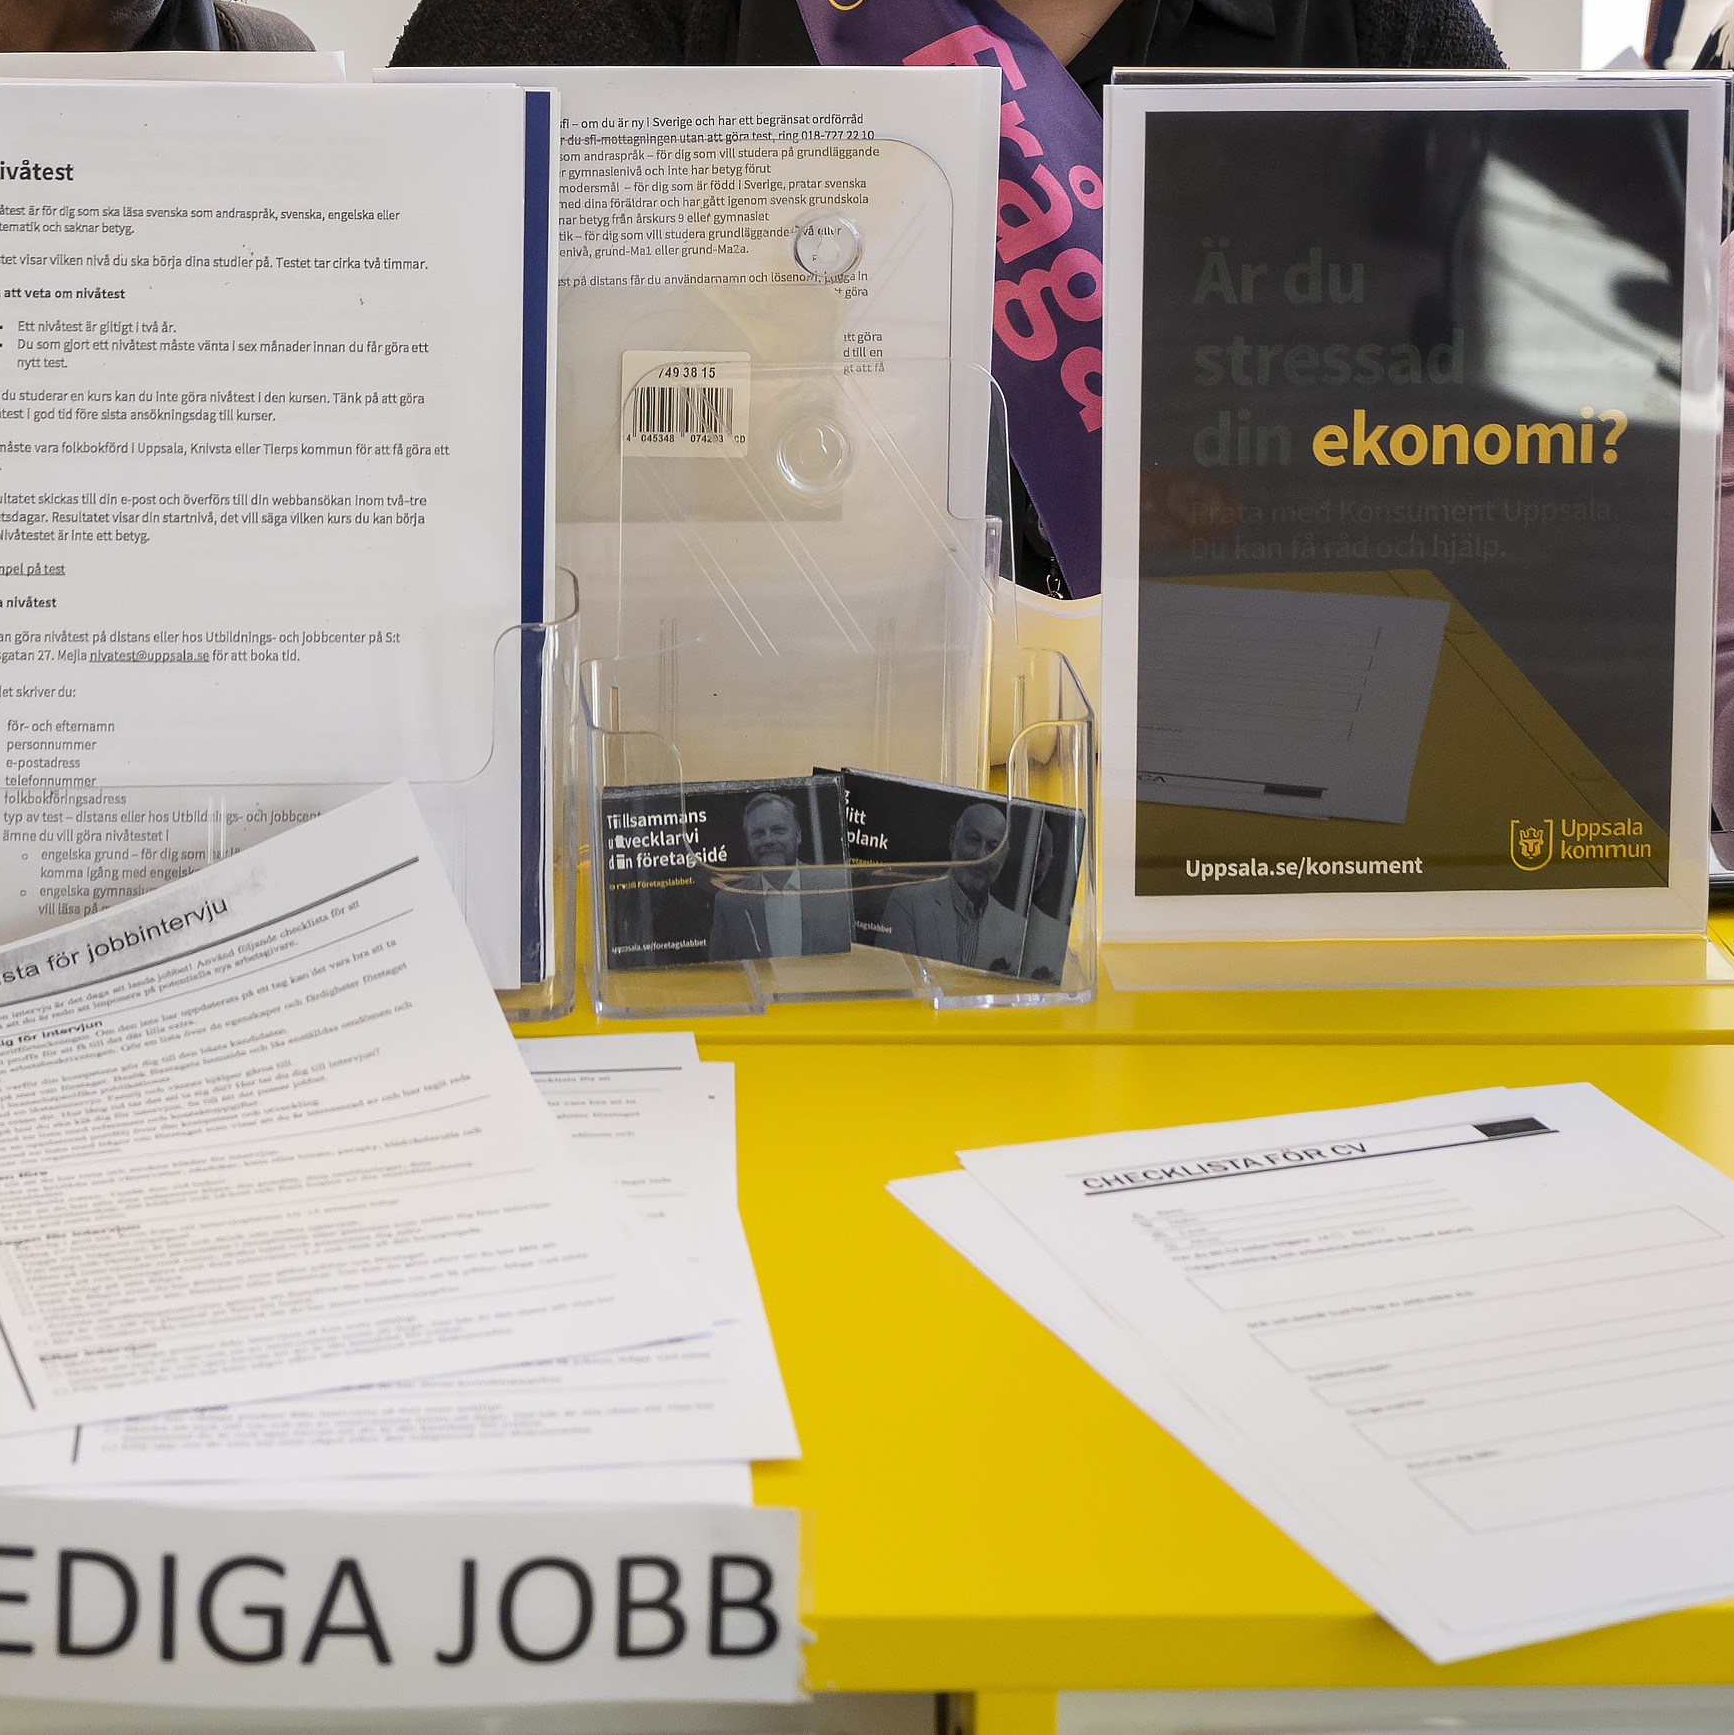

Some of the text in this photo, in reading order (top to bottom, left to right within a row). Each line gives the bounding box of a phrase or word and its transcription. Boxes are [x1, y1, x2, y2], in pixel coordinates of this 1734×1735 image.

[568, 162, 771, 180] gymnasienivå och inte har betyg förut
[1192, 235, 1364, 306] Är du
[4, 287, 22, 298] att
[24, 288, 51, 299] veta
[54, 290, 73, 299] om
[75, 286, 126, 299] nivåtest
[1193, 329, 1465, 388] stressad
[683, 367, 697, 379] 38
[701, 367, 716, 379] 15
[1192, 405, 1628, 468] din ekonomi?
[25, 562, 42, 576] på
[41, 564, 66, 576] test
[6, 595, 57, 608] nivåtest
[15, 685, 56, 698] skriver
[57, 685, 76, 698] du:
[7, 718, 115, 732] för- och efternamn
[6, 740, 97, 753] personnummer
[5, 756, 80, 771] e-postadress
[5, 773, 96, 788] telefonnummer
[685, 827, 700, 844] vi
[1560, 817, 1644, 841] Uppsala
[608, 844, 729, 871] dn företagsidé
[1560, 840, 1652, 862] kommun
[1185, 855, 1424, 882] Uppsala.se/konsument
[46, 950, 81, 973] för
[86, 897, 229, 963] jobbintervju
[18, 1031, 38, 1044] för
[1082, 1141, 1368, 1190] CHECKLISTA FÖR CV
[434, 1554, 781, 1666] JOBB
